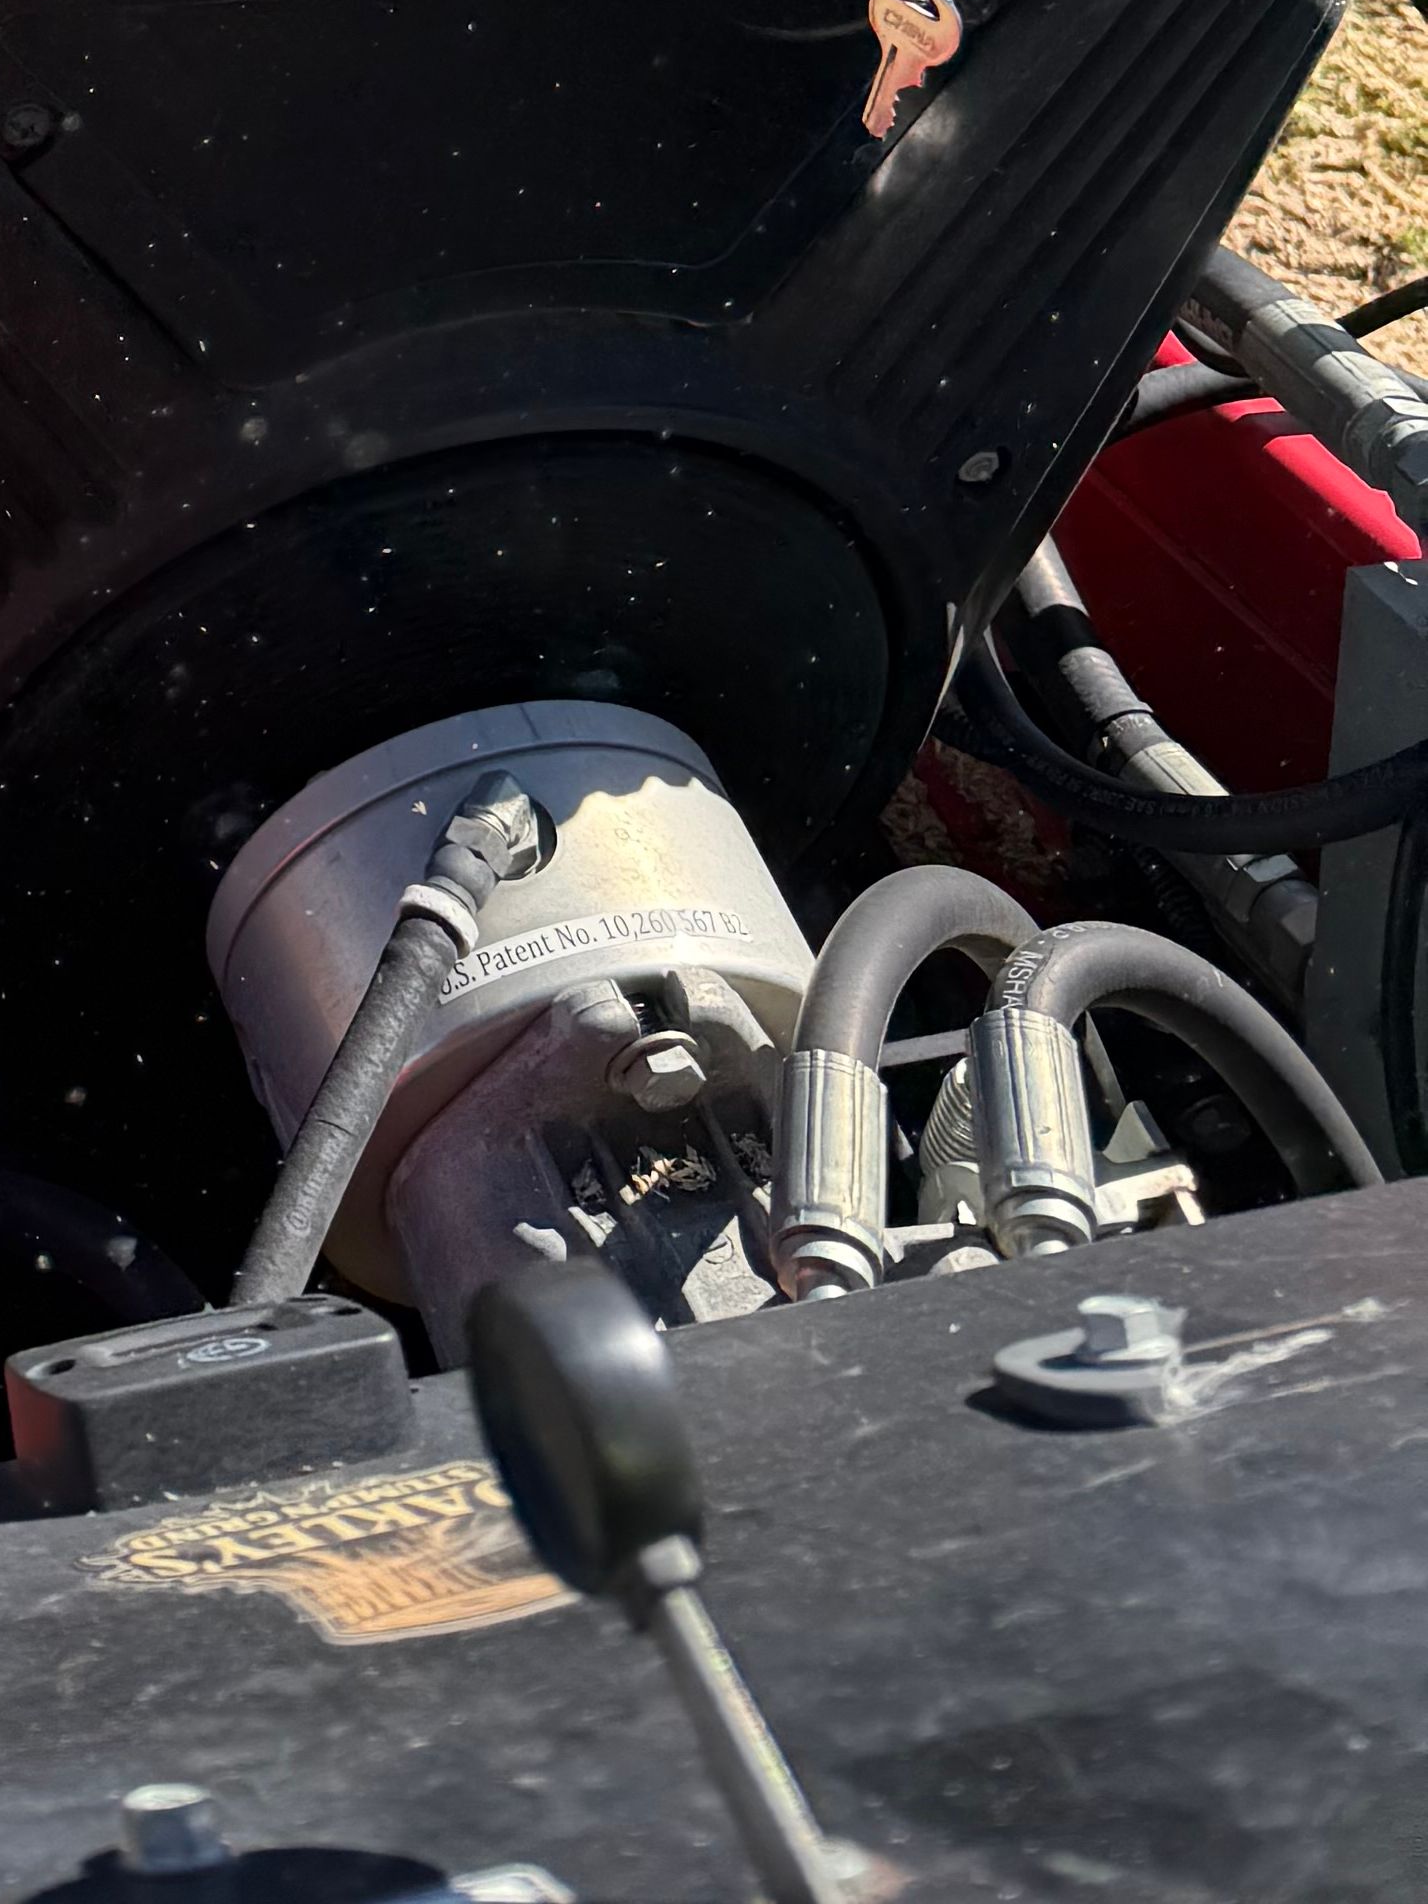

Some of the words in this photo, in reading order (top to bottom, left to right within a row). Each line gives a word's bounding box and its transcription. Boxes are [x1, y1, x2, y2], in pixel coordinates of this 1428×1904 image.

[476, 934, 555, 976] Patent
[555, 925, 597, 949] No.
[719, 911, 748, 936] B2
[1001, 950, 1043, 1009] MSHA
